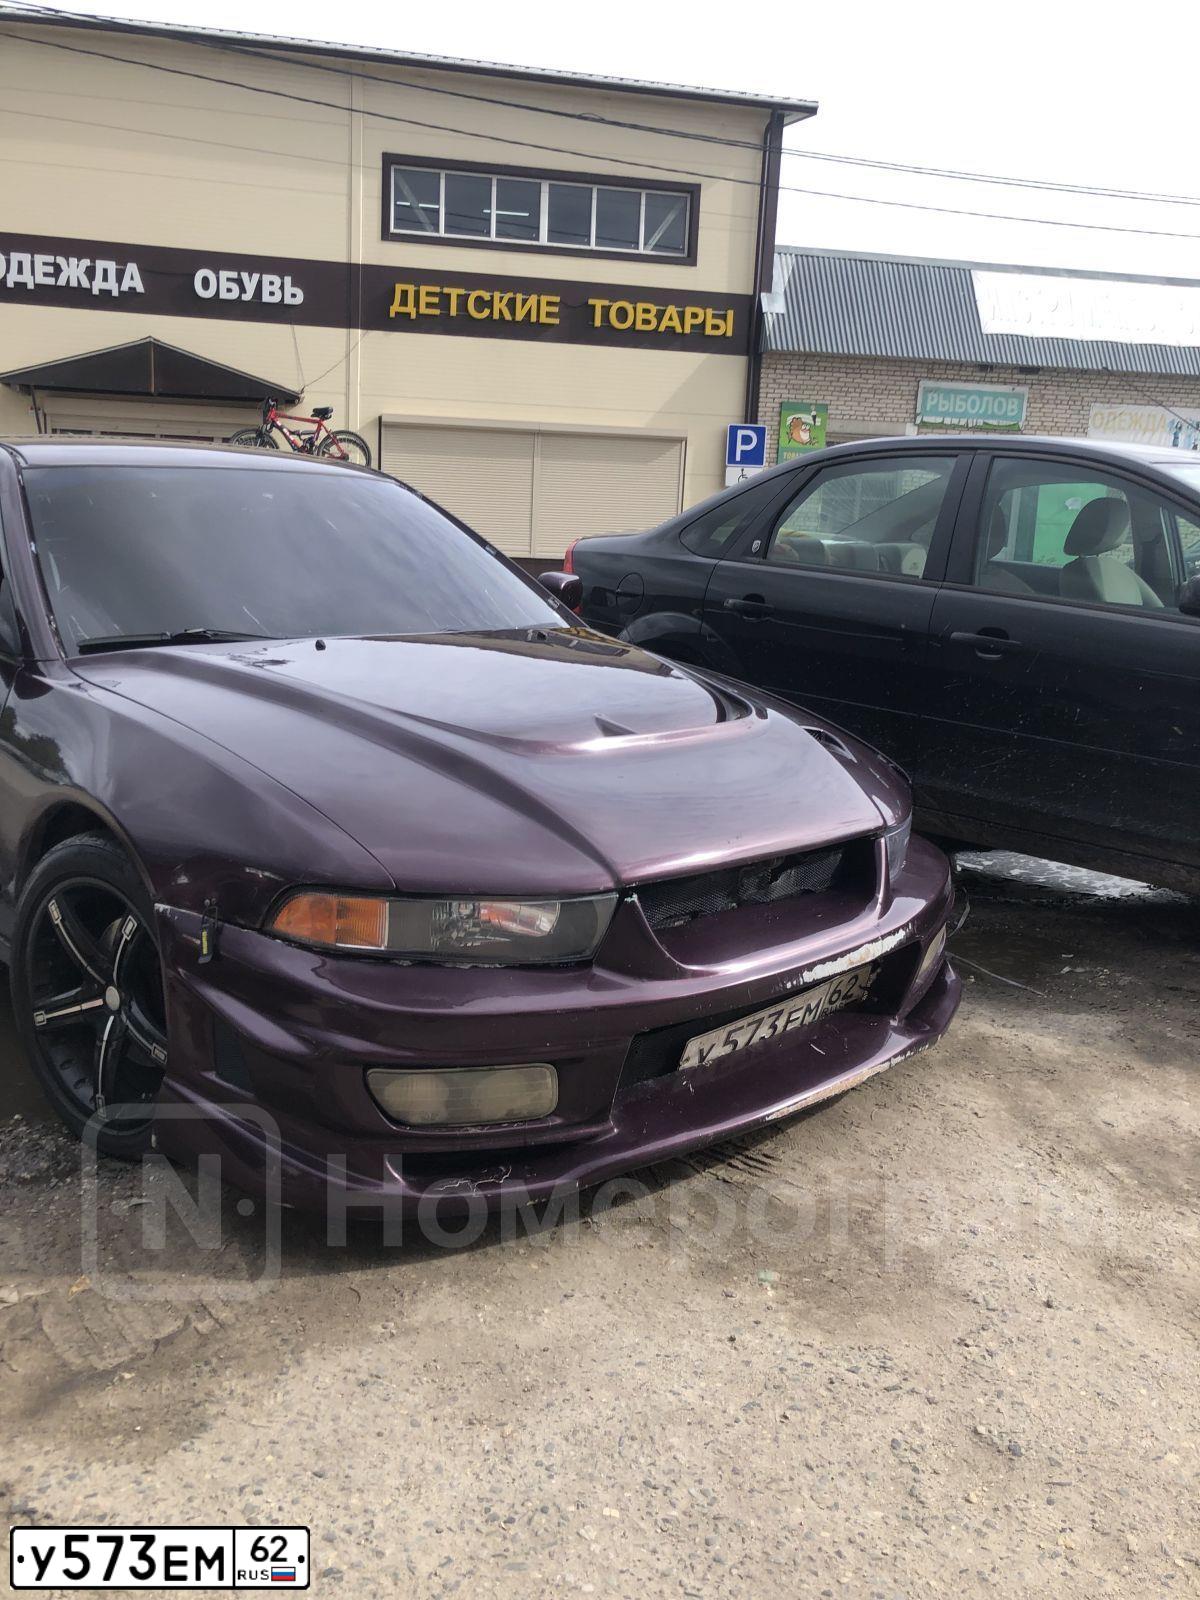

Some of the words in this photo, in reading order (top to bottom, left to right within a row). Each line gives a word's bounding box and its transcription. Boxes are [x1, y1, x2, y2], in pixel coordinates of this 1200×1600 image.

[194, 268, 304, 306] ОБУВЬ
[389, 283, 561, 325] ДЕТСКИЕ
[587, 298, 734, 337] ТОВАРЫ
[926, 392, 1019, 416] РЫБОЛОВ
[735, 429, 758, 462] P
[828, 974, 859, 1006] 62
